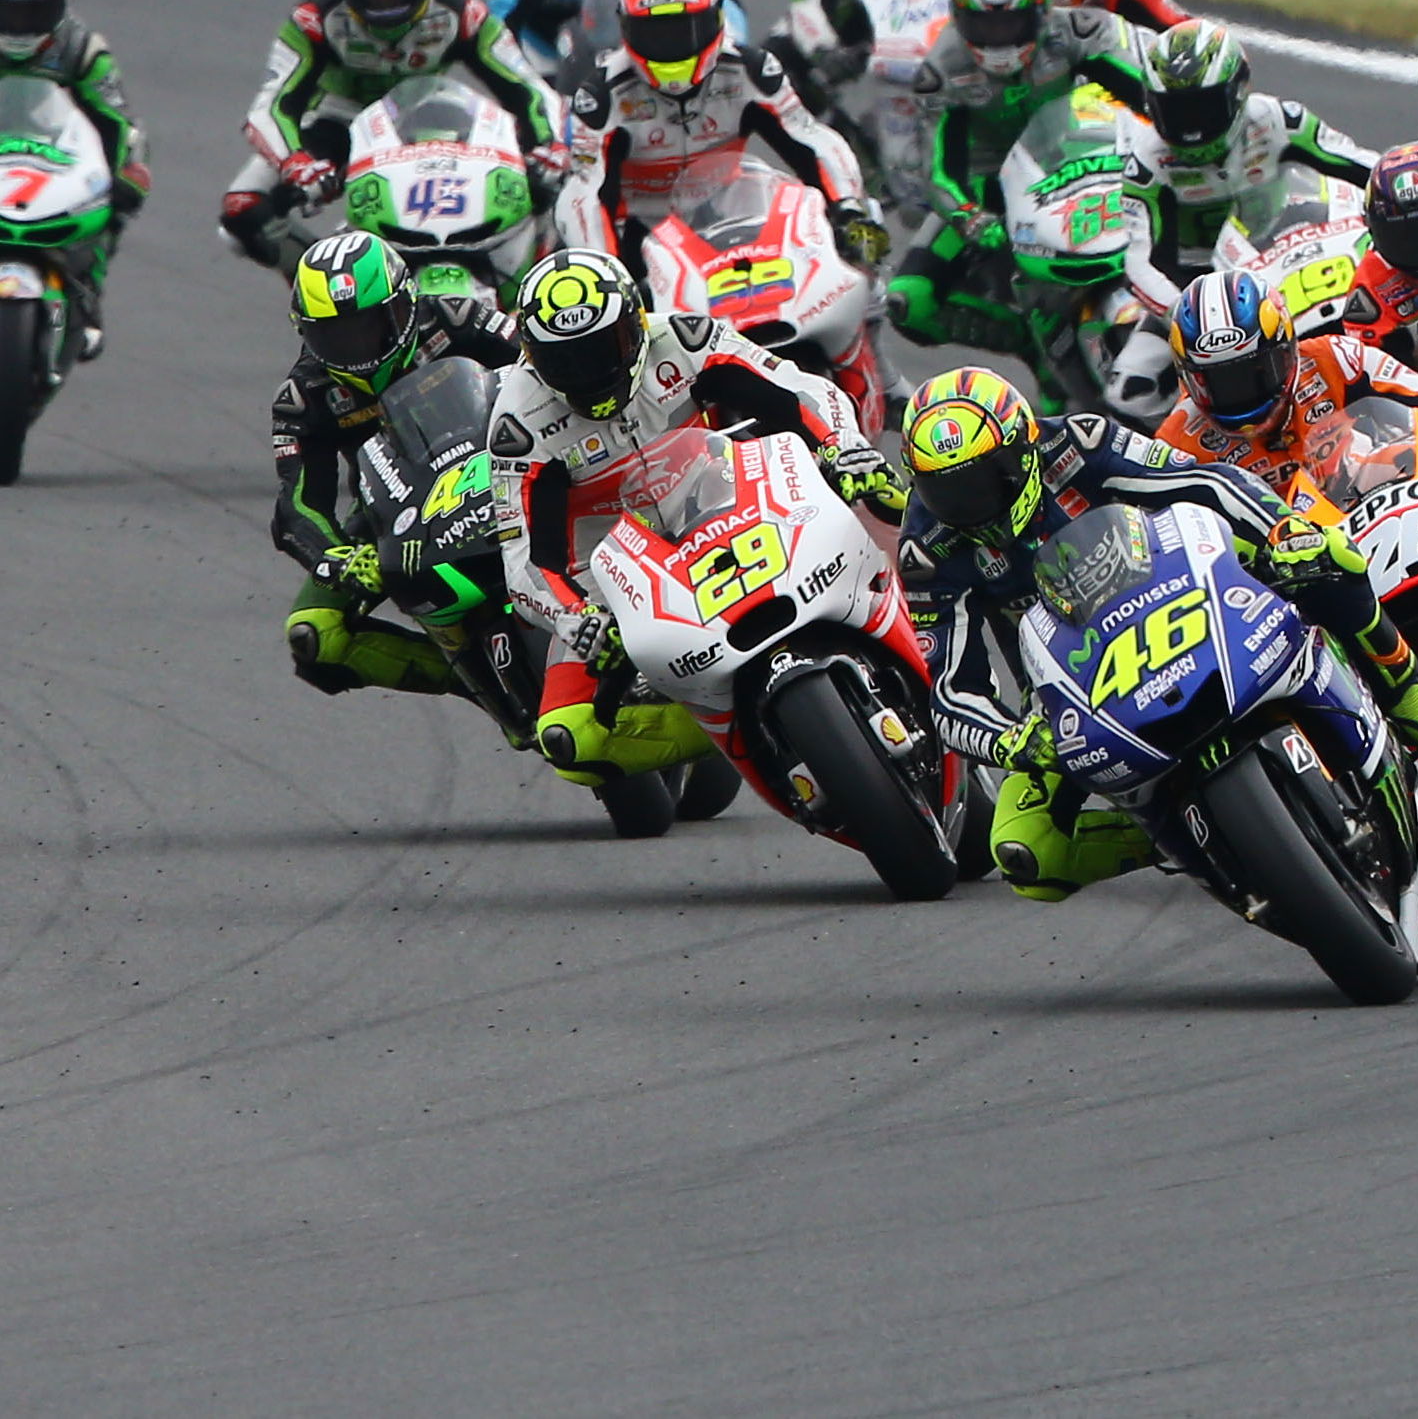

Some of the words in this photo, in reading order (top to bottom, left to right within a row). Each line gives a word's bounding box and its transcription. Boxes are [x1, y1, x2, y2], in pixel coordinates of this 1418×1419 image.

[404, 178, 468, 228] 45
[1247, 216, 1364, 270] ARRACUDA
[1276, 256, 1355, 317] 19
[1203, 333, 1239, 349] Arai
[1307, 404, 1334, 420] Arai
[429, 441, 476, 472] YAMAHA
[741, 440, 763, 482] RIELLO
[936, 437, 960, 452] agv
[421, 450, 492, 524] 44
[780, 435, 807, 503] PRAMAC
[614, 518, 648, 556] RIELLO
[663, 505, 761, 571] PRAMAC
[1152, 509, 1184, 555] YAMAHA
[595, 549, 645, 611] PRAMAC
[688, 521, 789, 627] 29
[796, 552, 849, 605] Lifter
[981, 559, 1007, 577] agv
[1100, 573, 1191, 633] movistar
[1090, 588, 1208, 709] 46
[1243, 607, 1285, 653] ENEOS
[668, 641, 724, 680] Lifter
[1133, 653, 1194, 701] SEMAKIN
[1066, 746, 1110, 772] ENEOS
